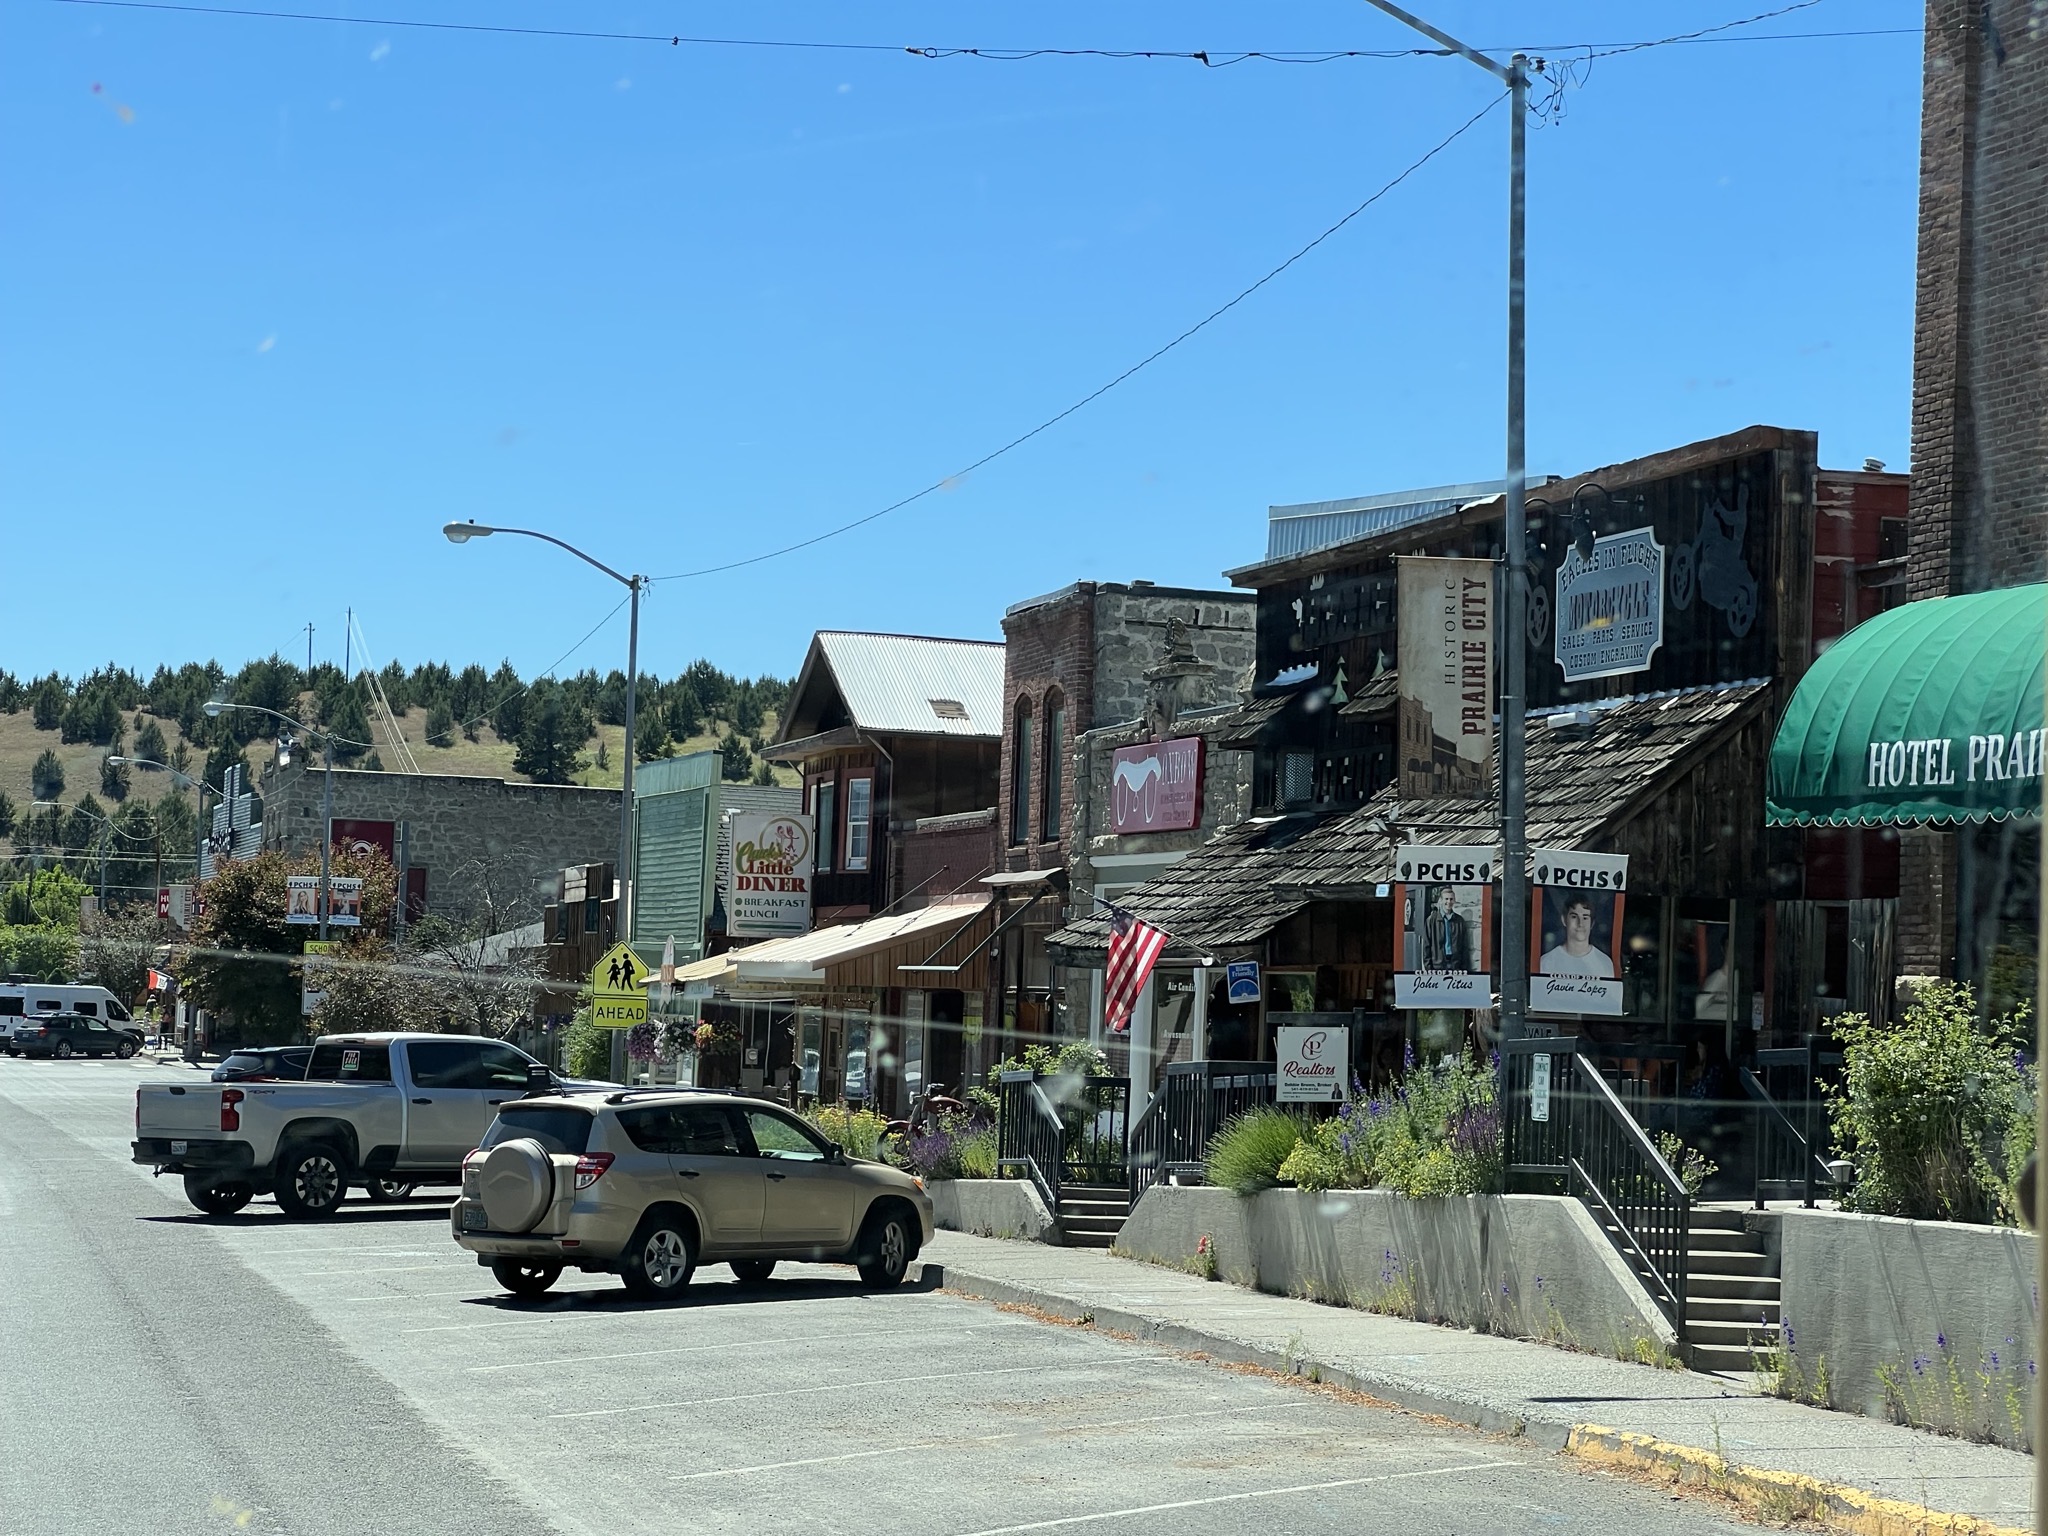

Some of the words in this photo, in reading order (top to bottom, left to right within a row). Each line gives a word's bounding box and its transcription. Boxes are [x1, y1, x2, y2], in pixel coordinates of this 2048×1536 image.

[1561, 550, 1600, 594] EAGLES
[1604, 546, 1616, 570] IN
[1621, 542, 1658, 575] FLIGHT
[1462, 577, 1486, 631] CITY
[1568, 580, 1650, 632] MOTORCYCLE
[1445, 579, 1456, 684] HISTORIC
[1562, 634, 1585, 650] SALES
[1592, 628, 1614, 644] PARTS
[1621, 621, 1654, 640] SERVICE
[1570, 652, 1597, 669] CUSTOM
[1600, 644, 1644, 664] ENGRAVING
[1462, 641, 1486, 735] PRAIRIE
[1867, 738, 1955, 787] HOTEL
[747, 859, 794, 875] Little
[1417, 863, 1475, 881] PCHS
[736, 875, 808, 892] DINER
[1553, 867, 1609, 888] PCHS
[743, 898, 806, 907] BREAKFAST
[743, 910, 779, 918] LUNCH
[1231, 969, 1255, 978] Friendly
[1167, 981, 1177, 991] Air
[1178, 982, 1196, 992] Condi
[1412, 976, 1439, 993] John
[1442, 976, 1473, 990] Titus
[1546, 979, 1575, 995] Gavin
[1577, 981, 1607, 998] Lopez
[596, 1006, 645, 1020] AHEAD
[1283, 1061, 1336, 1078] Realtors
